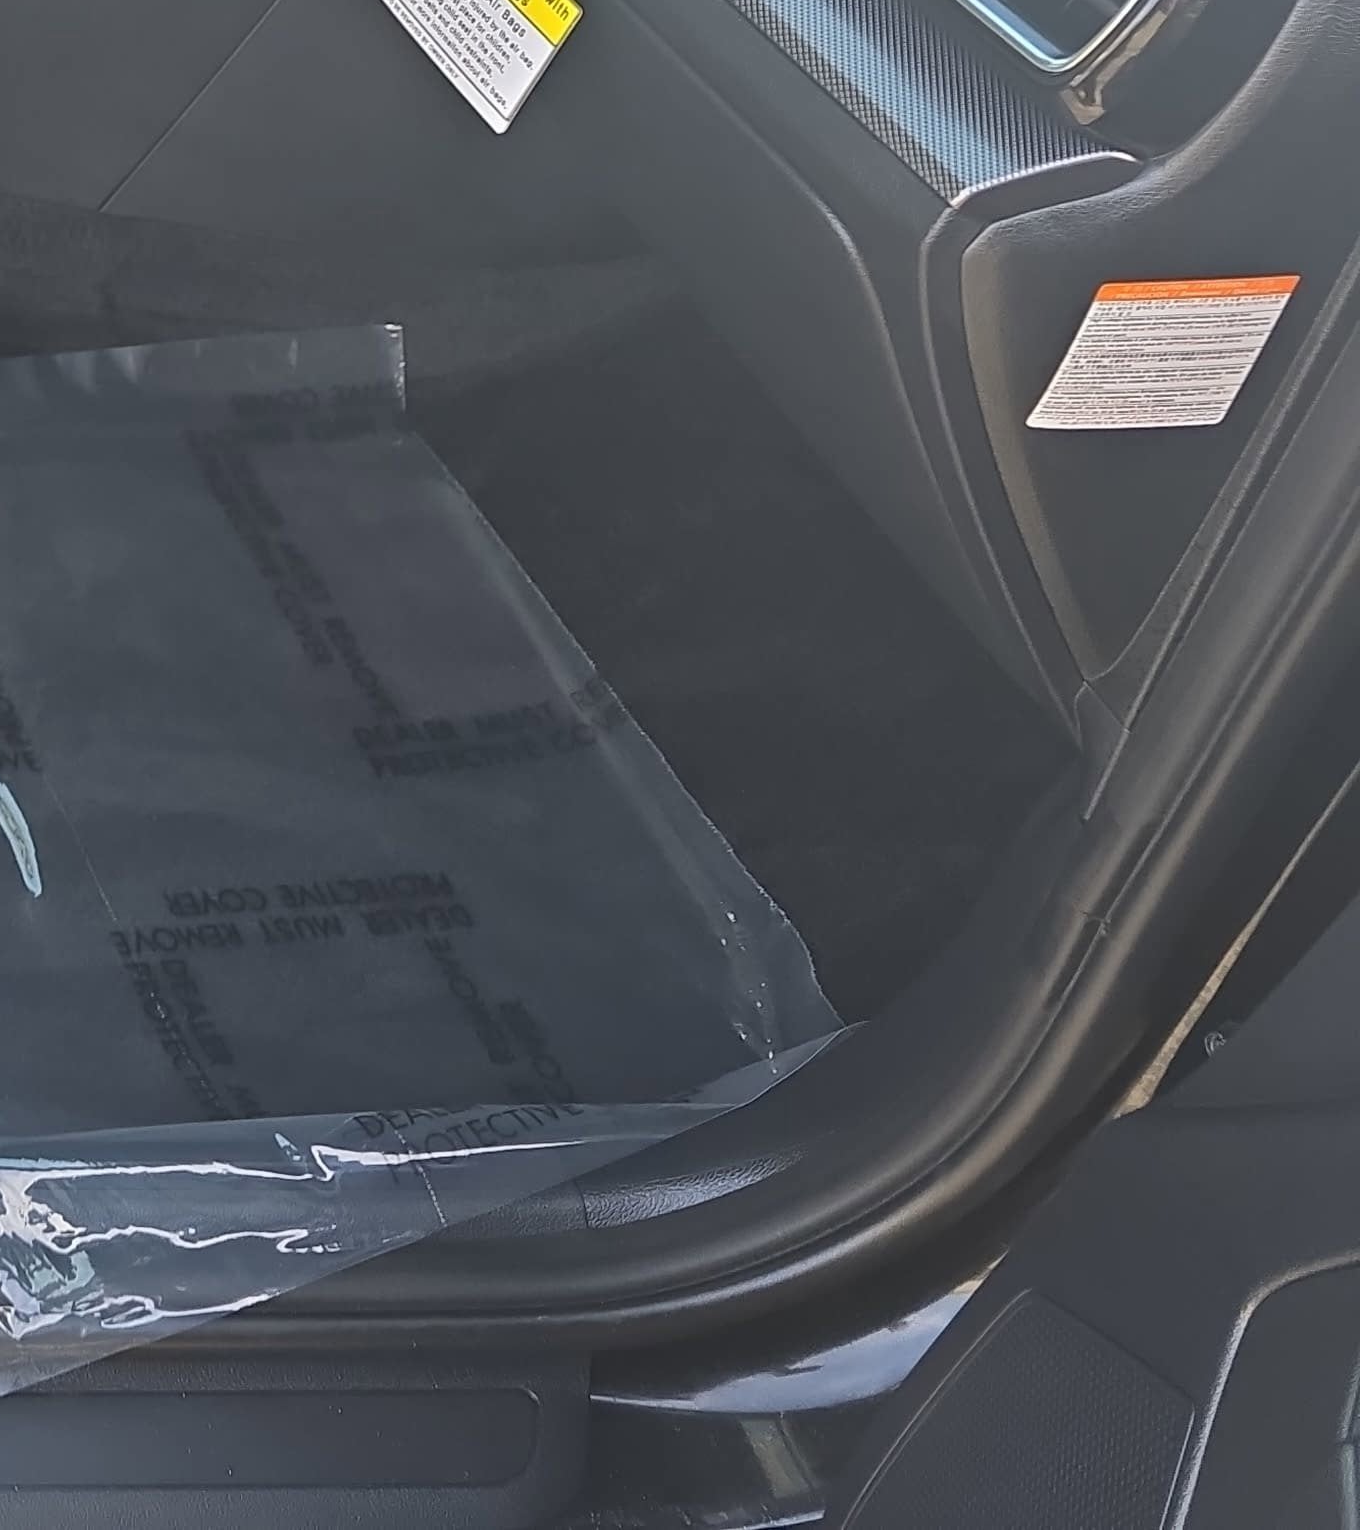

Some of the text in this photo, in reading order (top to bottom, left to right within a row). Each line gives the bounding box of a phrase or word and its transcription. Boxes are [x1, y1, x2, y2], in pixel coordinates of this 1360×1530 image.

[458, 3, 476, 25] place
[475, 21, 486, 35] for
[500, 7, 527, 40] Bags
[489, 20, 499, 33] by
[498, 28, 510, 44] the
[509, 40, 520, 54] air
[162, 886, 268, 917] COVER
[109, 921, 247, 957] REMOVE
[259, 915, 347, 948] MUST
